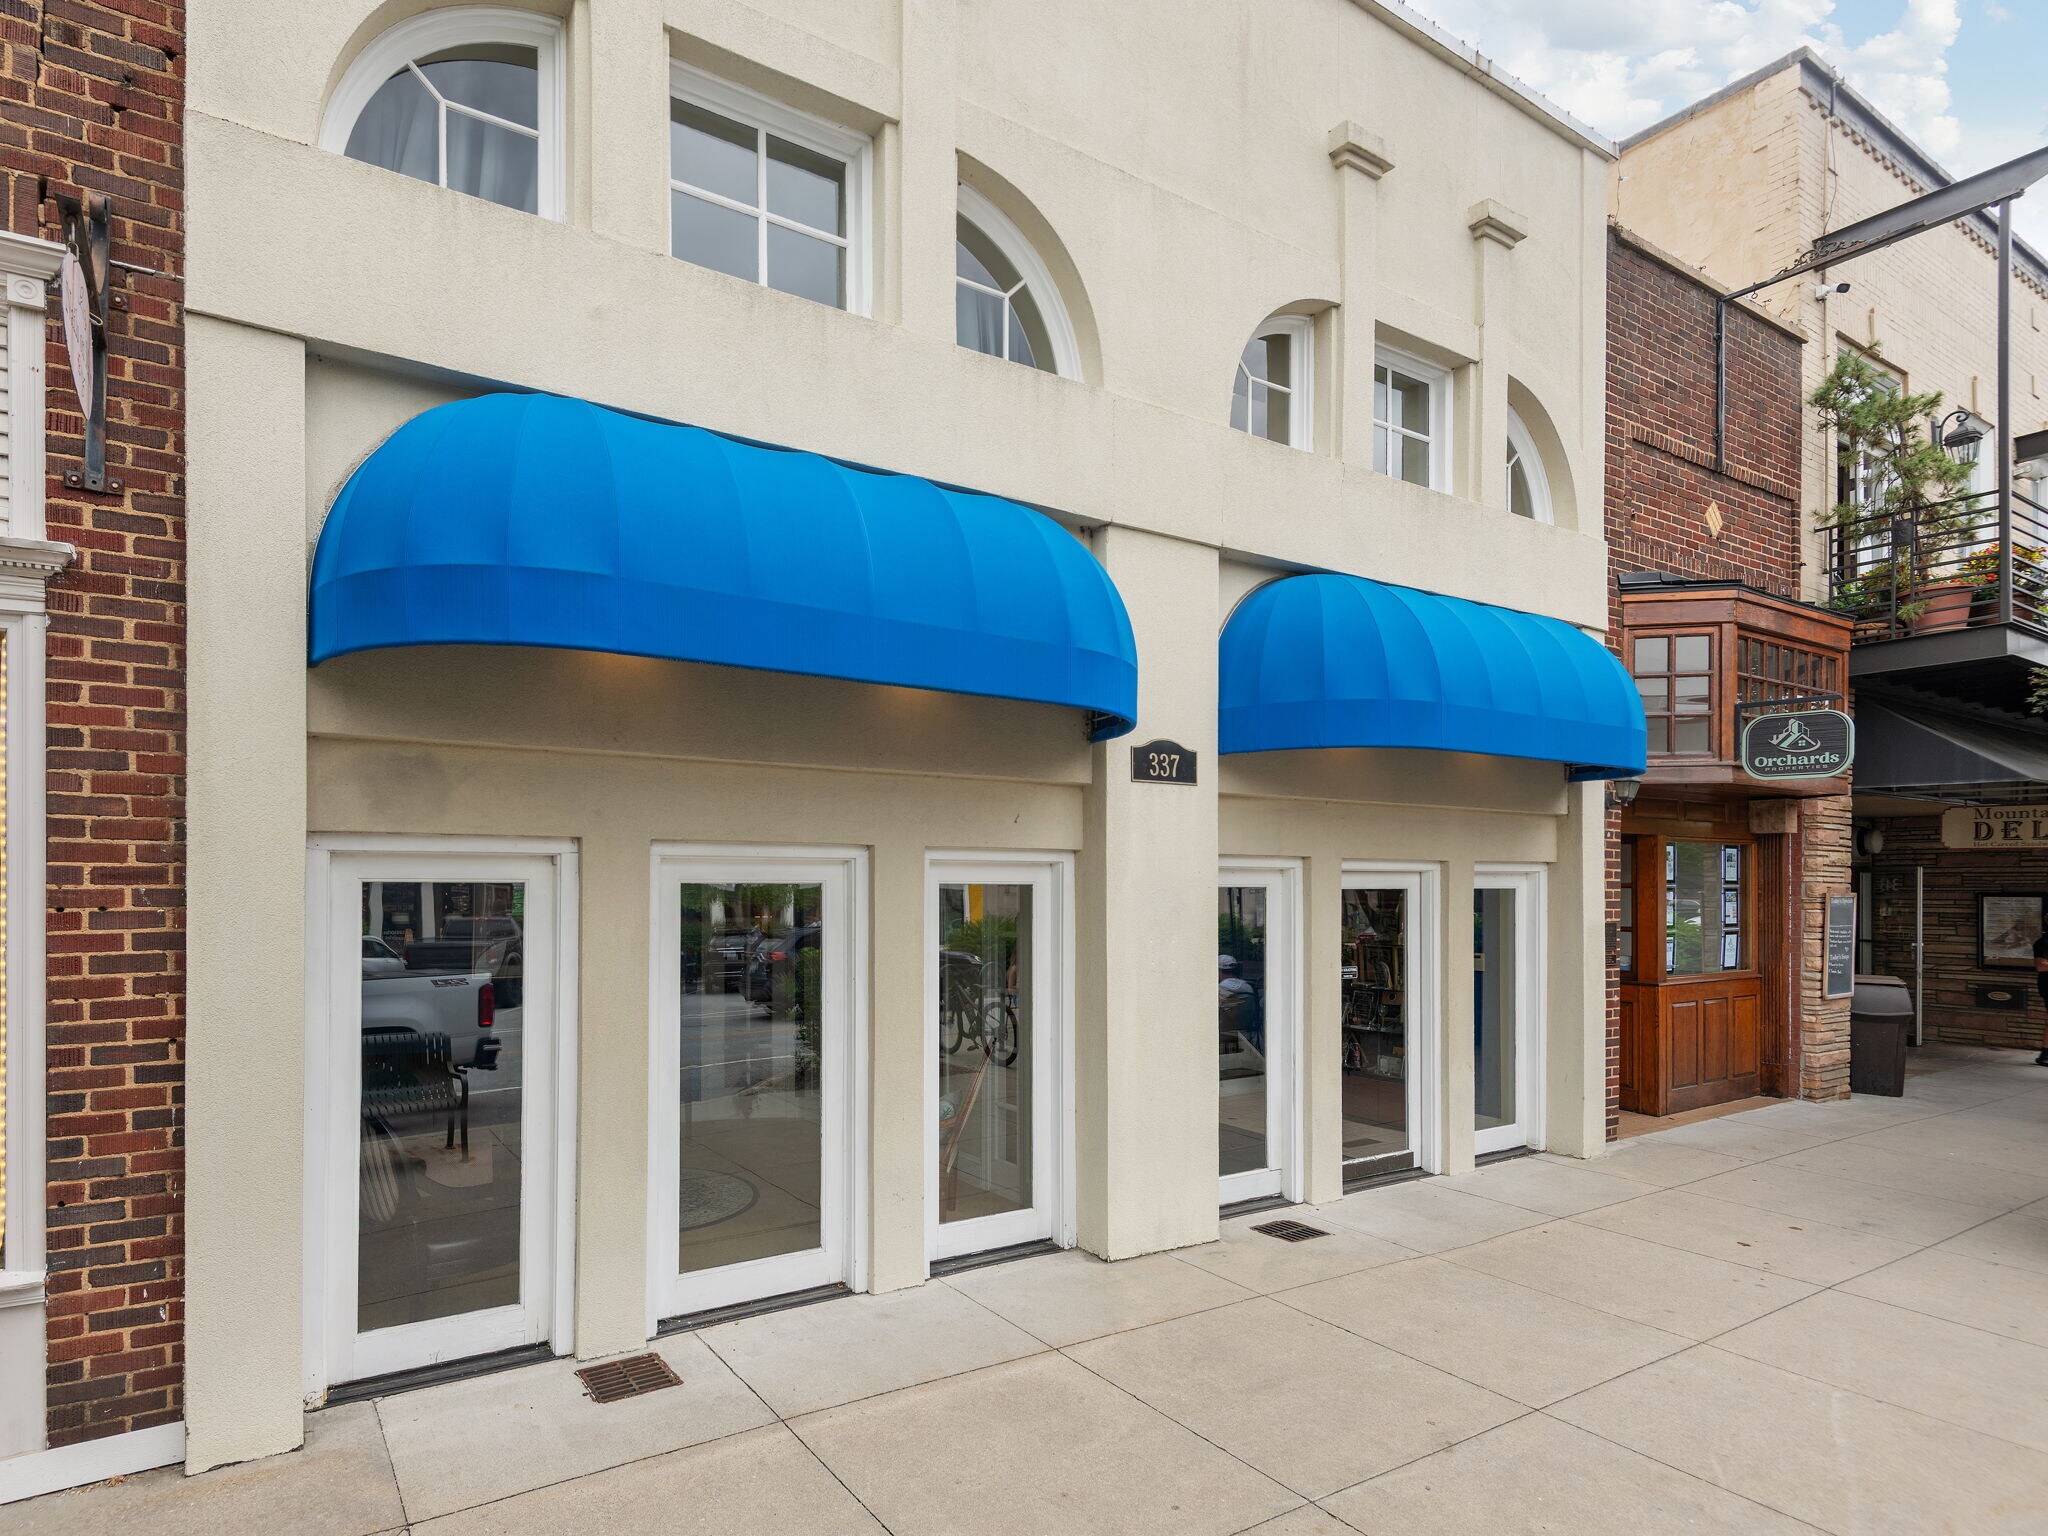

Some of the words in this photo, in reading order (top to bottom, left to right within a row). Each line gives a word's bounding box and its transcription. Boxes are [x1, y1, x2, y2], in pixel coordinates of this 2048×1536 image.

[1149, 752, 1180, 778] 337
[1754, 752, 1840, 767] Orchards
[1764, 764, 1828, 772] PROPERTIES
[1973, 820, 2048, 841] DEL
